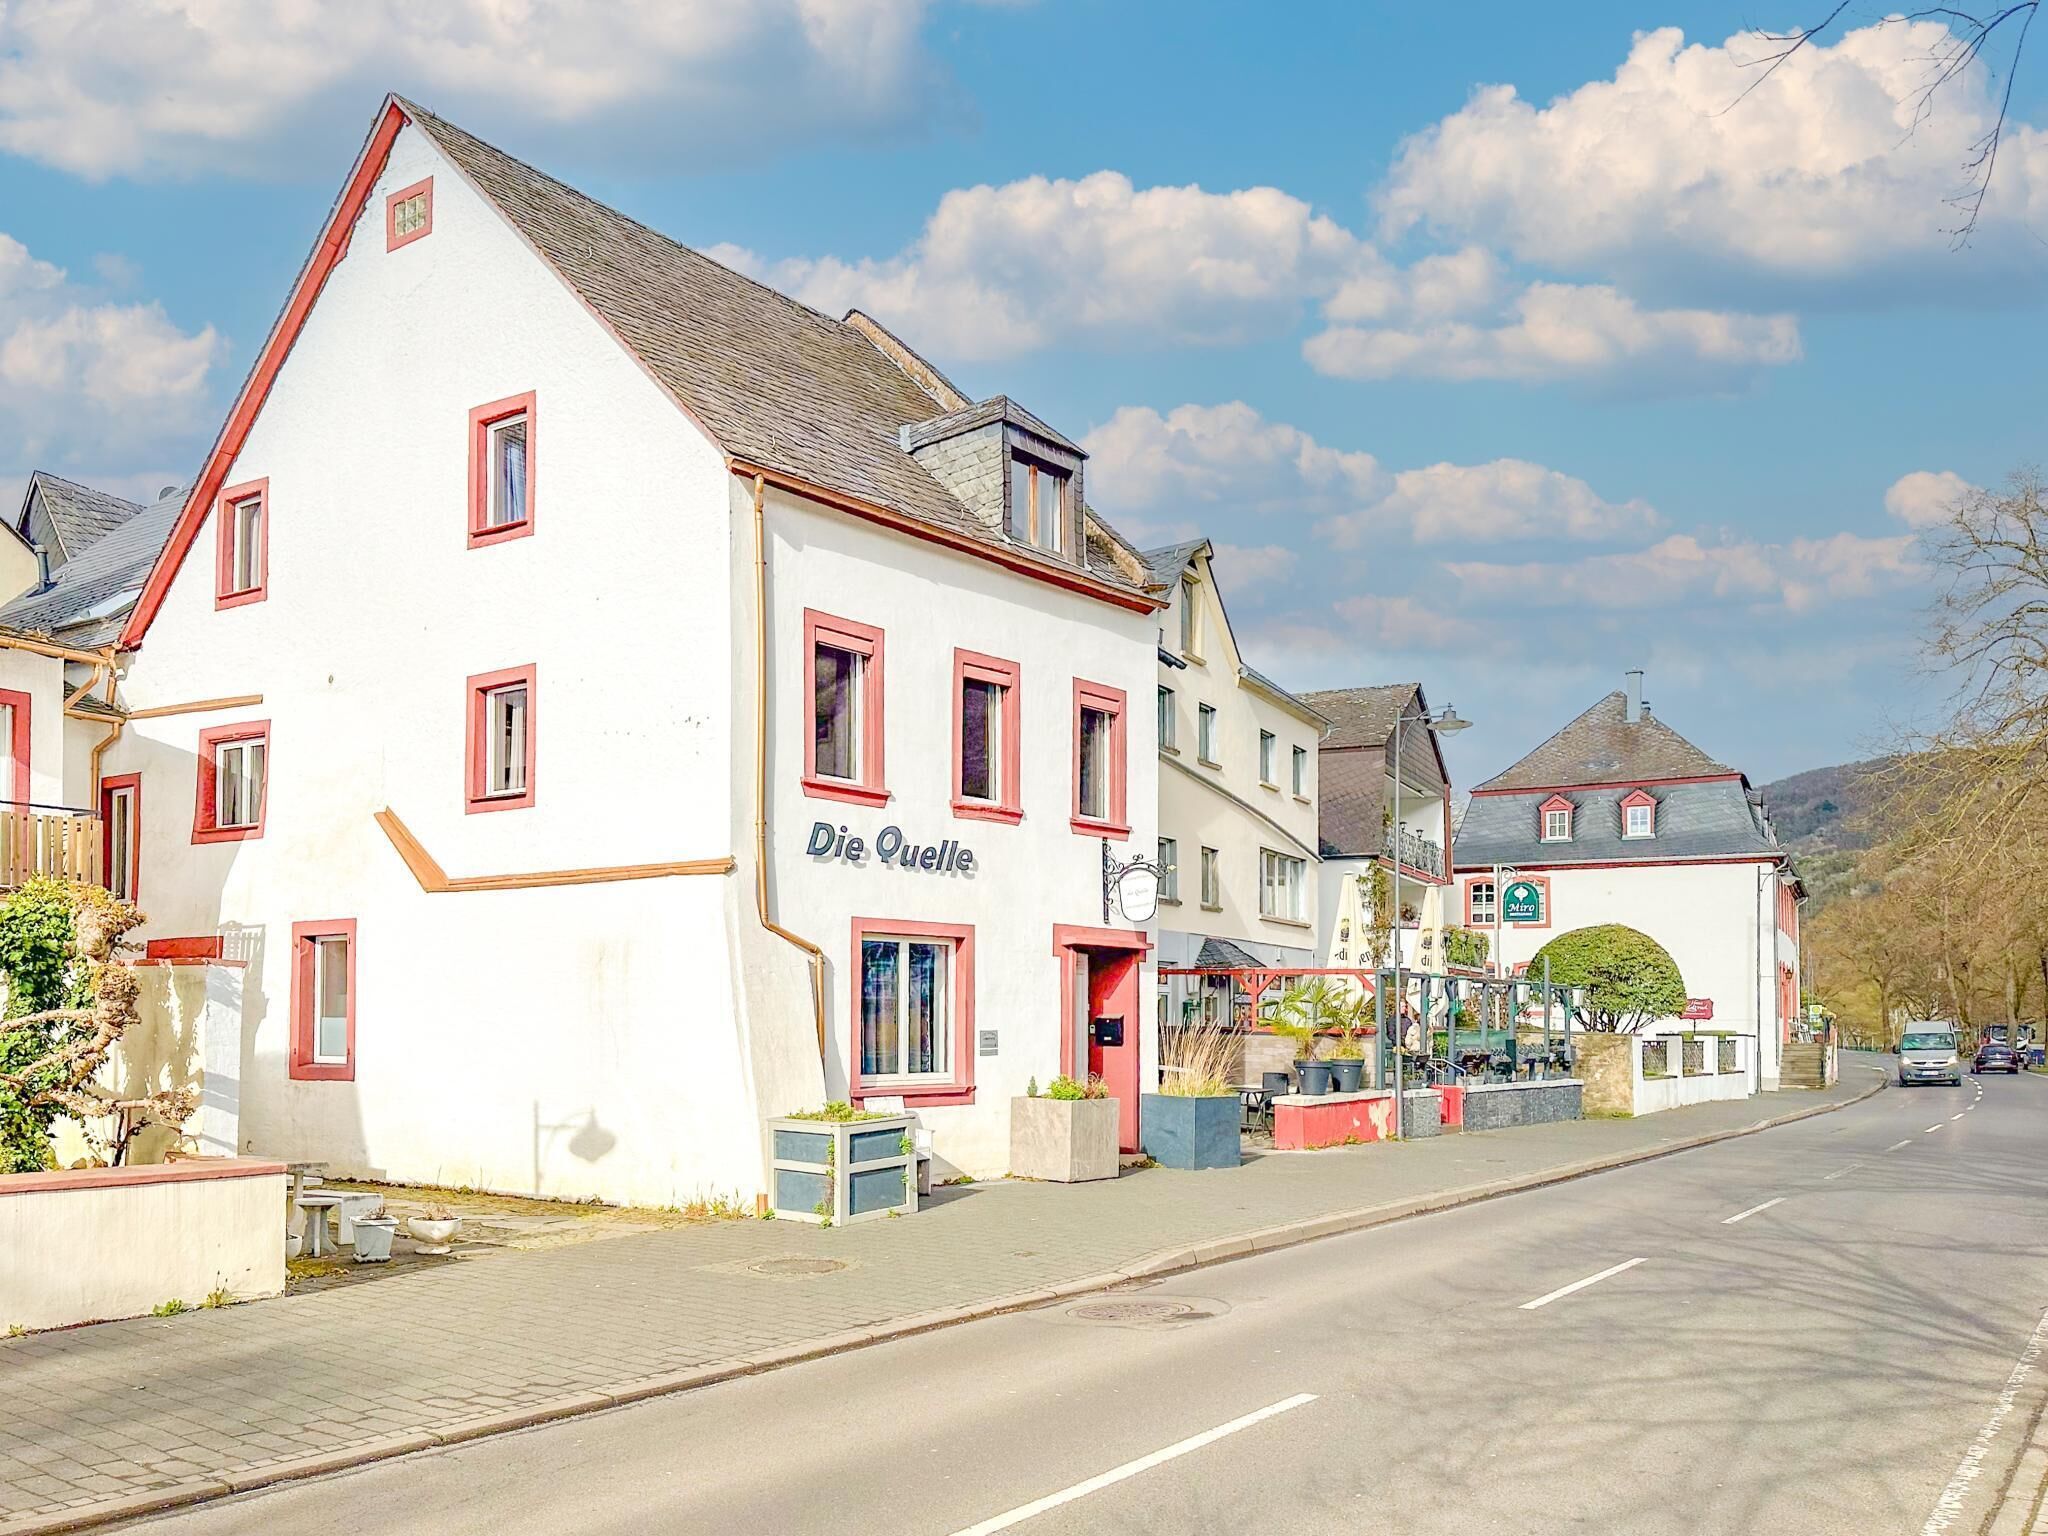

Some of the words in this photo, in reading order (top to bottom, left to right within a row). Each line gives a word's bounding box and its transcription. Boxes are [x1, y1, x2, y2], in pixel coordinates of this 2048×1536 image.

[806, 822, 864, 860] Die
[876, 825, 973, 871] Quelle
[1507, 902, 1535, 912] Miro
